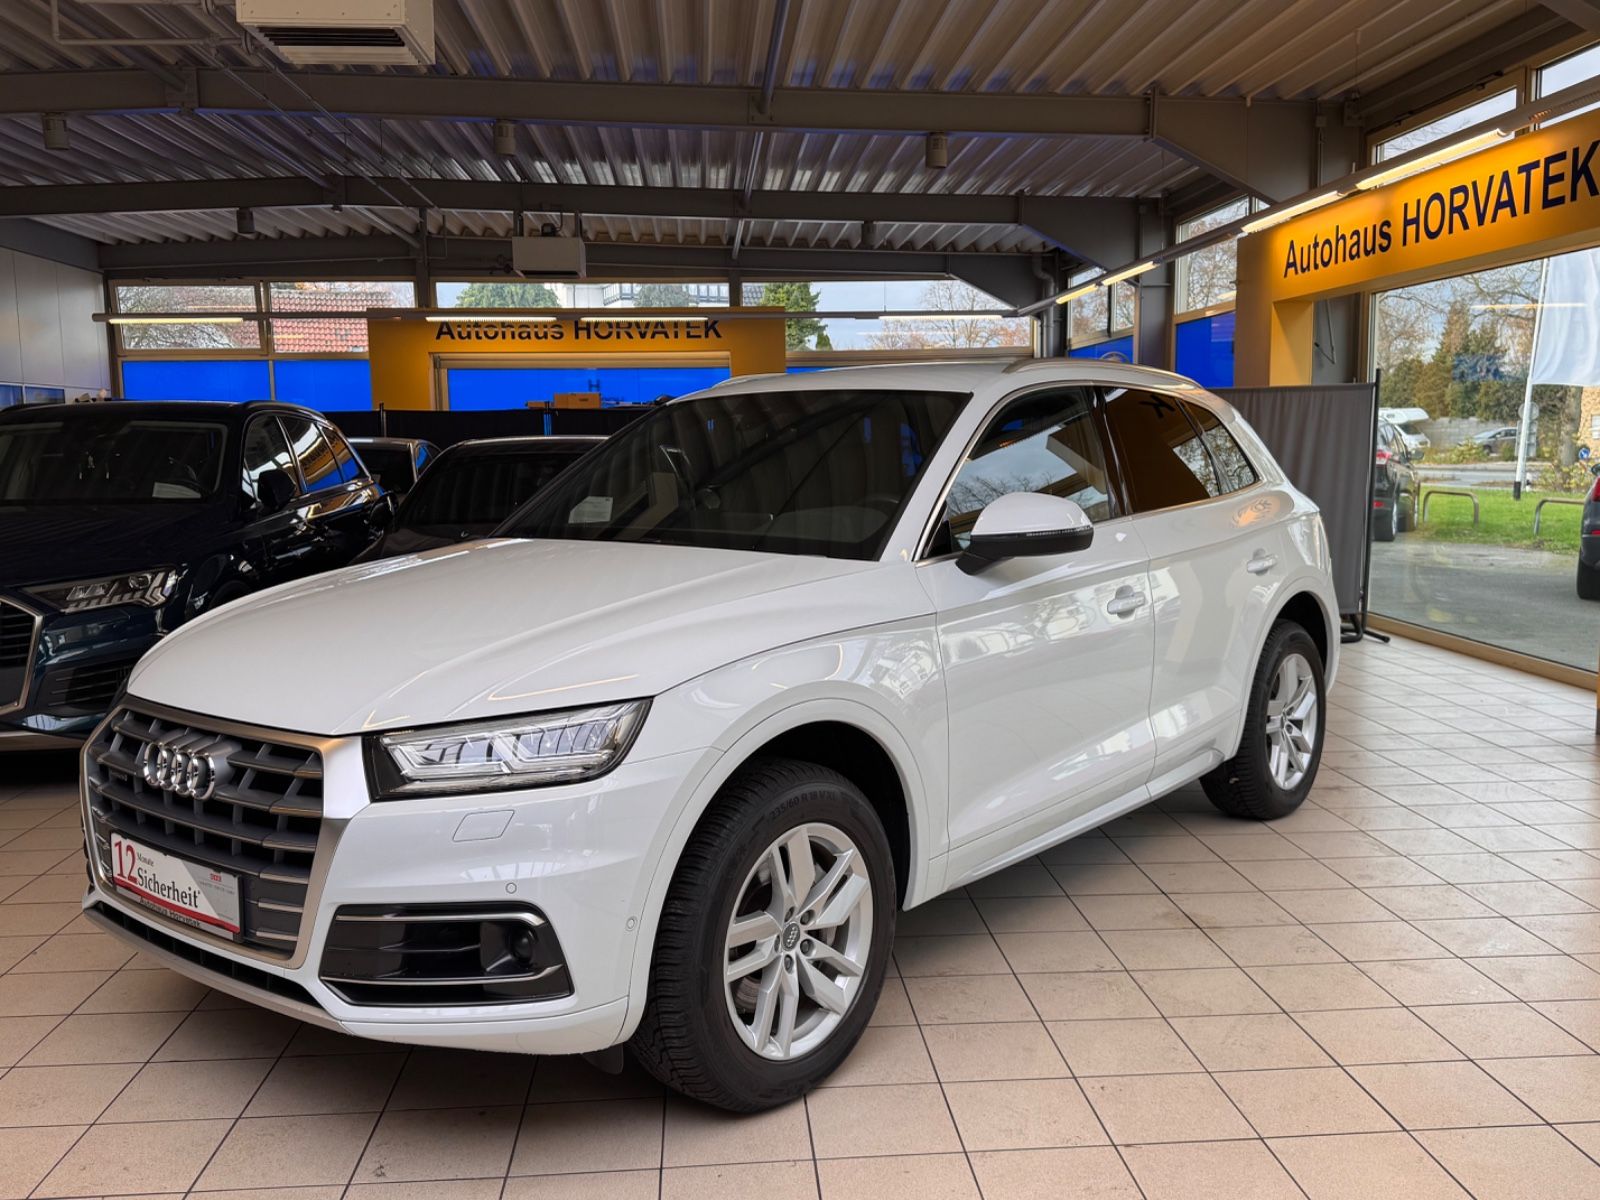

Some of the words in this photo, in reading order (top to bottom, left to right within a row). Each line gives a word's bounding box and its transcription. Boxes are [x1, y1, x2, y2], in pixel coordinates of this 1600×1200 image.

[1283, 219, 1392, 279] Autohaus
[1402, 140, 1600, 247] HORVATEK
[436, 320, 565, 340] Autohaus
[574, 319, 722, 339] HORVATEK
[114, 840, 138, 885] 12
